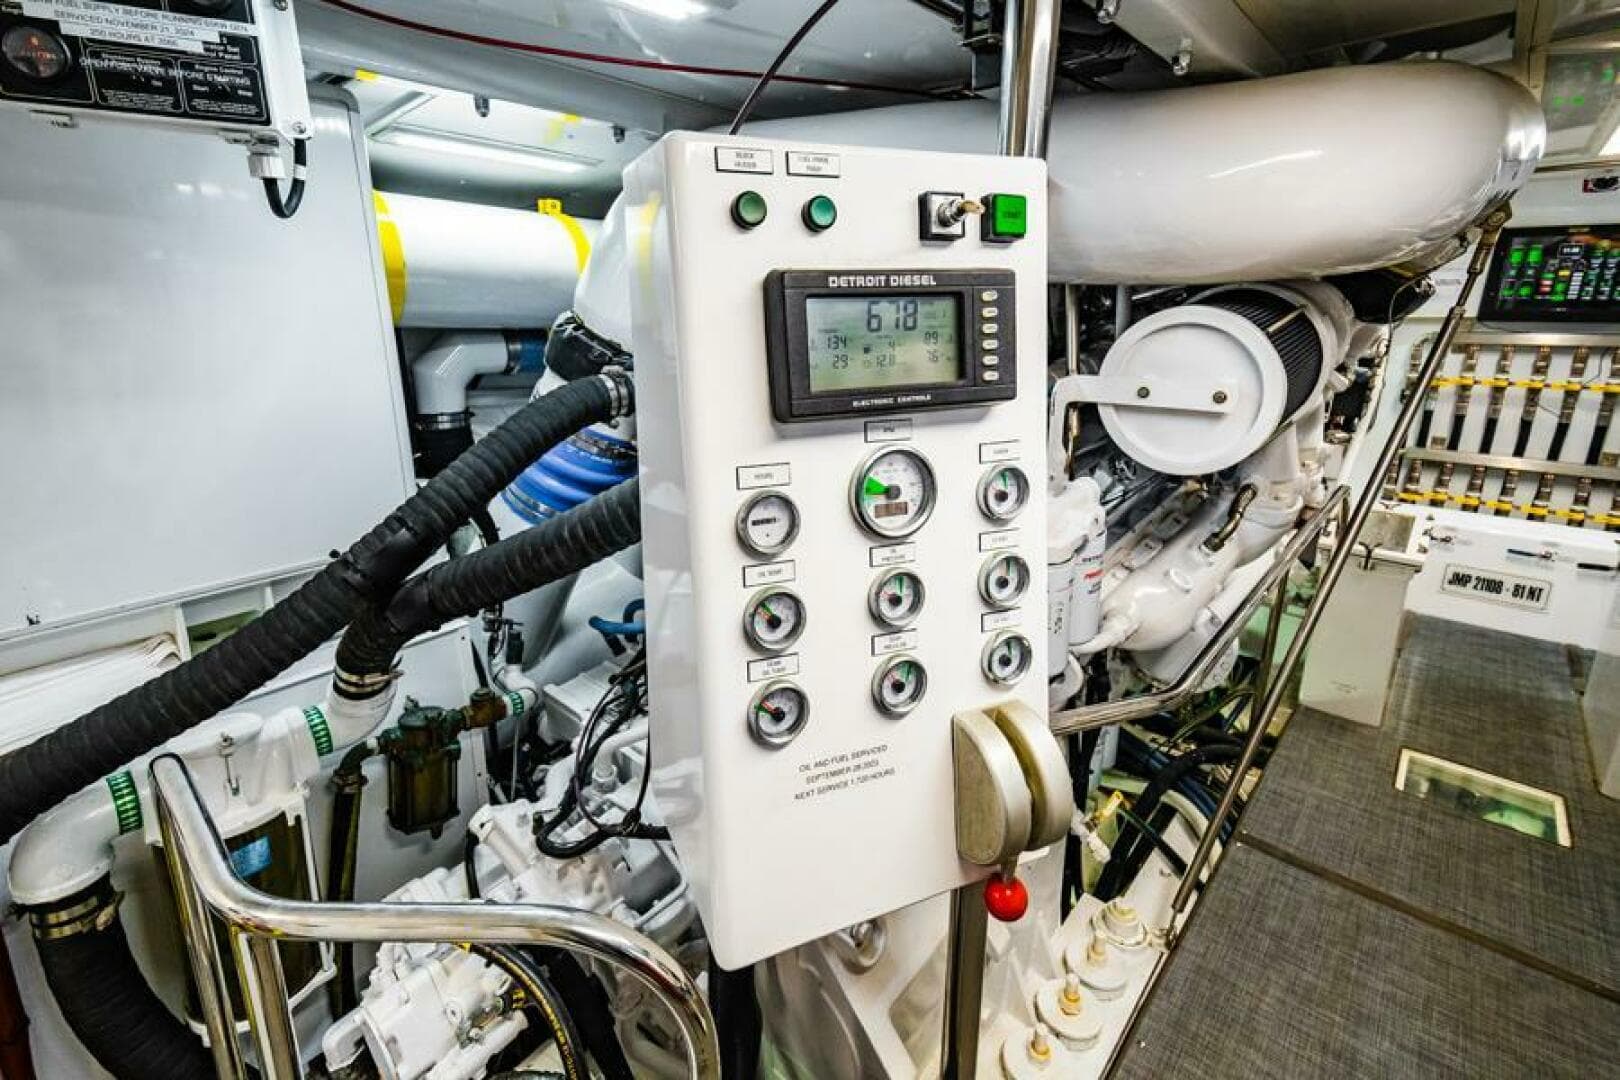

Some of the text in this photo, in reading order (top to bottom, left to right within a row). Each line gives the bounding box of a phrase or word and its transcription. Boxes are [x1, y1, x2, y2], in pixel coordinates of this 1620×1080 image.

[105, 17, 158, 31] NOVEMBER
[828, 274, 936, 287] DETROIT DIESEL
[867, 300, 918, 332] 678
[1448, 572, 1472, 587] JMP
[814, 758, 830, 768] AND
[851, 744, 888, 760] SERVICED
[806, 766, 851, 784] SEPTEMBER
[794, 788, 814, 800] NEXT
